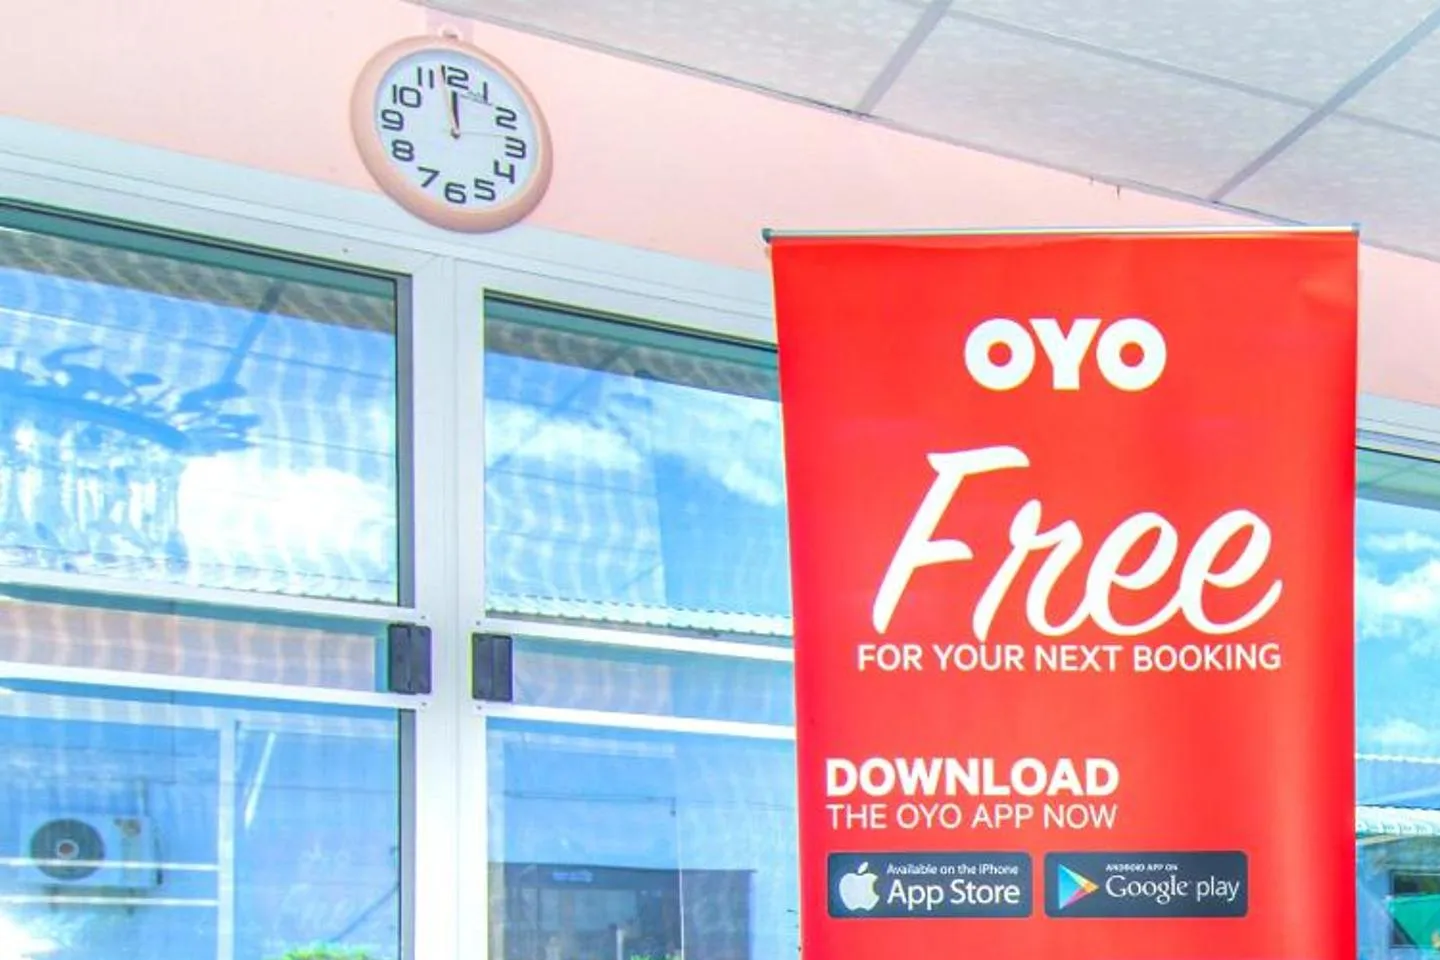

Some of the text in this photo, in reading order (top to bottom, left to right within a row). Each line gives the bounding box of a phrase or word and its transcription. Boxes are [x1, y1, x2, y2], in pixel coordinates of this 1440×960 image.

[416, 65, 435, 90] 11
[392, 83, 422, 109] 10
[482, 81, 489, 103] 1
[381, 108, 404, 132] 9
[495, 106, 518, 131] 2
[391, 138, 415, 163] 8
[504, 135, 527, 160] 3
[416, 165, 441, 189] 7
[493, 159, 516, 185] 4
[444, 180, 468, 205] 6
[473, 177, 497, 202] 5
[963, 317, 1167, 392] OYO
[871, 444, 1283, 642] Free
[857, 642, 1282, 672] FOR YOUR NEXT BOOKING
[825, 757, 1121, 798] DOWNLOAD
[826, 803, 1119, 830] THE OYO APP NOW
[886, 863, 1019, 875] Available on the iPhone
[1105, 863, 1179, 872] ANDROID APP ON
[887, 878, 1020, 911] App Store
[1105, 874, 1240, 905] Google play
